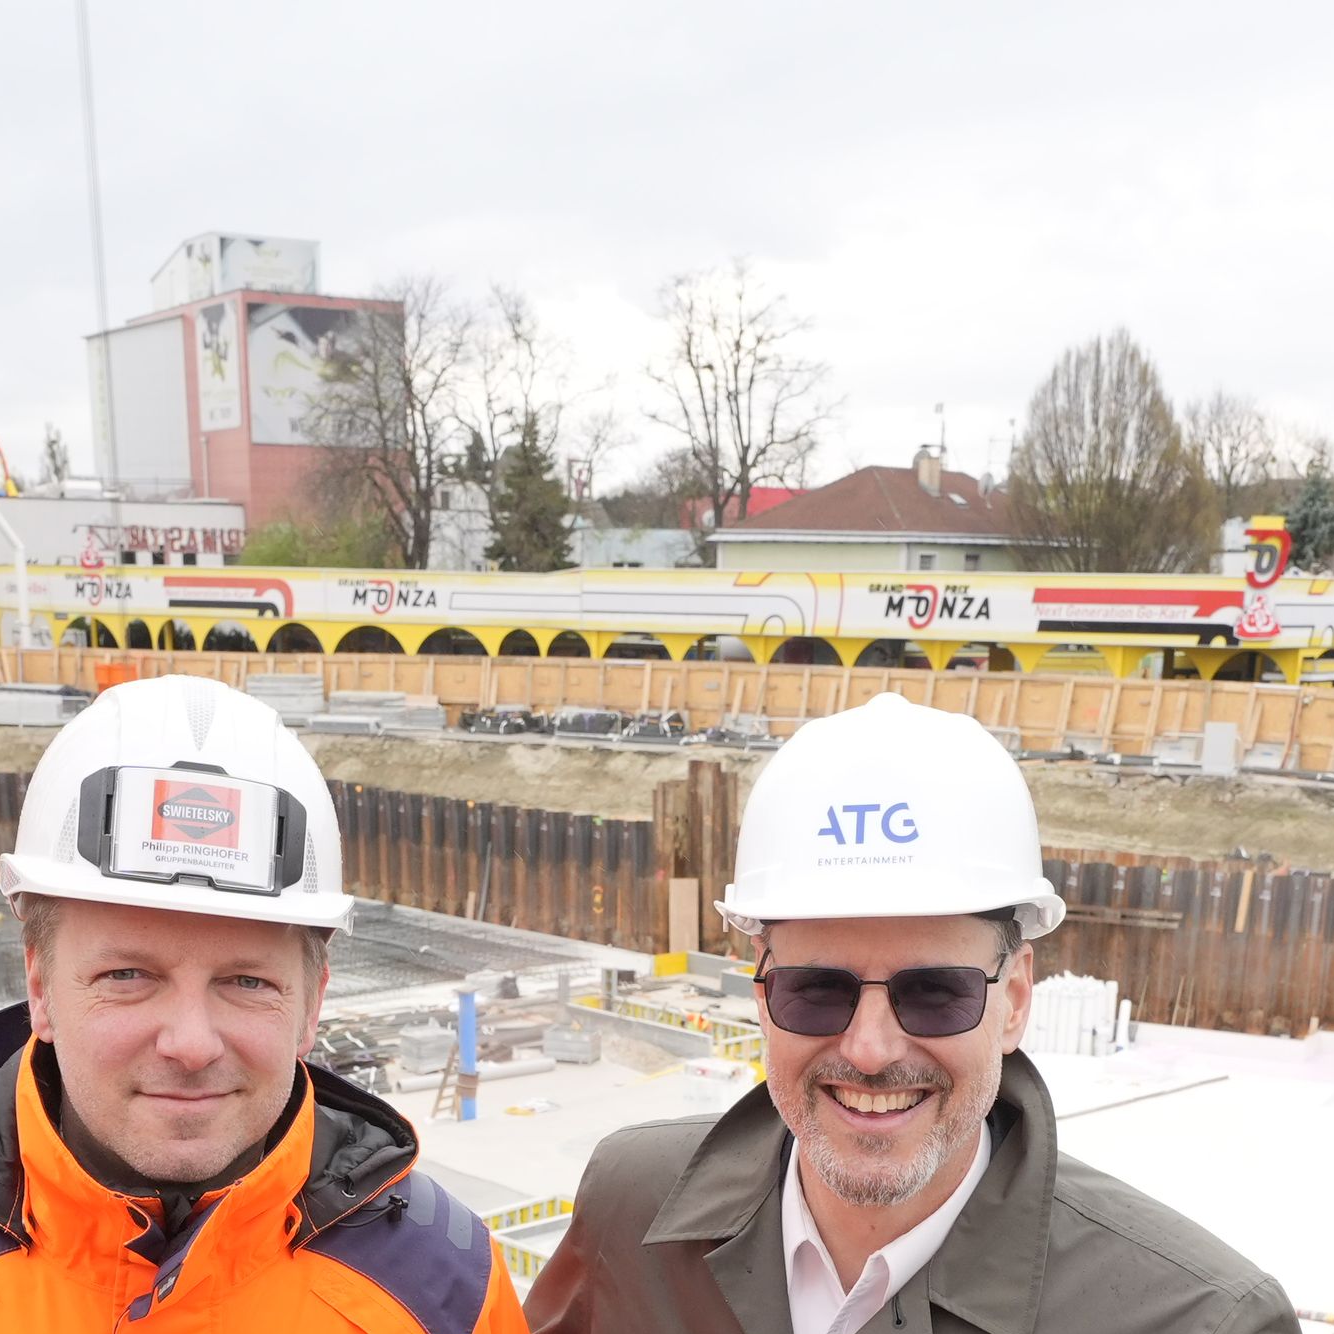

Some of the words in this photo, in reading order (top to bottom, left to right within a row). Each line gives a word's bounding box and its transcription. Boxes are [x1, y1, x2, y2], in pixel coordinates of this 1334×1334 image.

[353, 588, 437, 612] MONZA
[885, 595, 991, 626] MONZA
[162, 804, 231, 823] SWIETELSKY
[817, 802, 920, 845] ATG
[141, 841, 180, 854] Philipp
[182, 844, 250, 862] RINGHOFER
[817, 855, 914, 866] ENTERTAINMENT
[154, 855, 236, 870] GRUPPENBAULEITER
